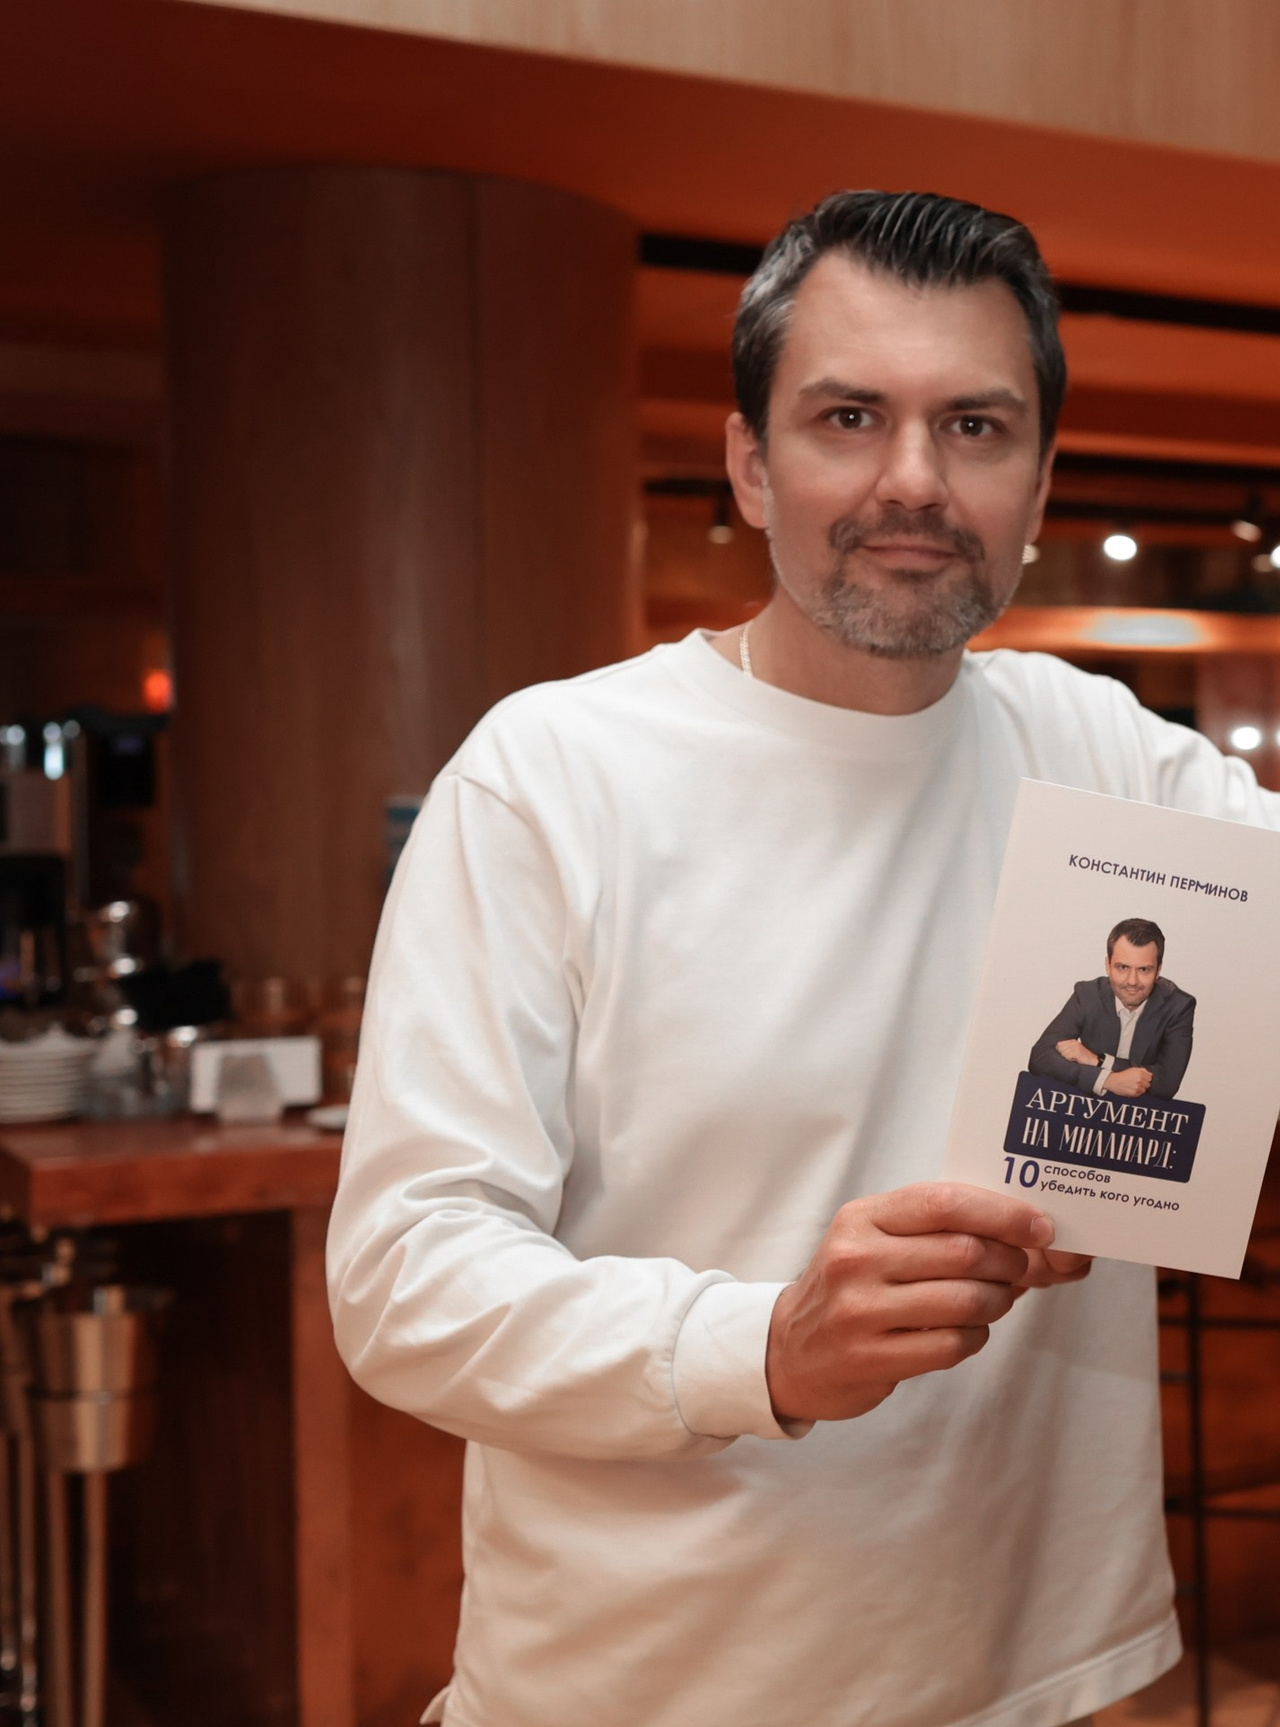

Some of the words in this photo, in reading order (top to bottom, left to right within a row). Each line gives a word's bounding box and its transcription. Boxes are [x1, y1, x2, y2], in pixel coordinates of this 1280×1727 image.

[1069, 854, 1167, 886] КОНСТАНТИН
[1169, 875, 1249, 902] ПЕРМИНОВ
[1025, 1087, 1190, 1136] АРГУМЕНТ
[1022, 1117, 1050, 1148] НА
[1058, 1123, 1178, 1170] МИЛЛИАРД:
[1003, 1156, 1040, 1189] 10
[1044, 1165, 1111, 1184] способов
[1040, 1180, 1096, 1198] убедить
[1099, 1190, 1130, 1203] кого
[1133, 1195, 1180, 1211] угодно
